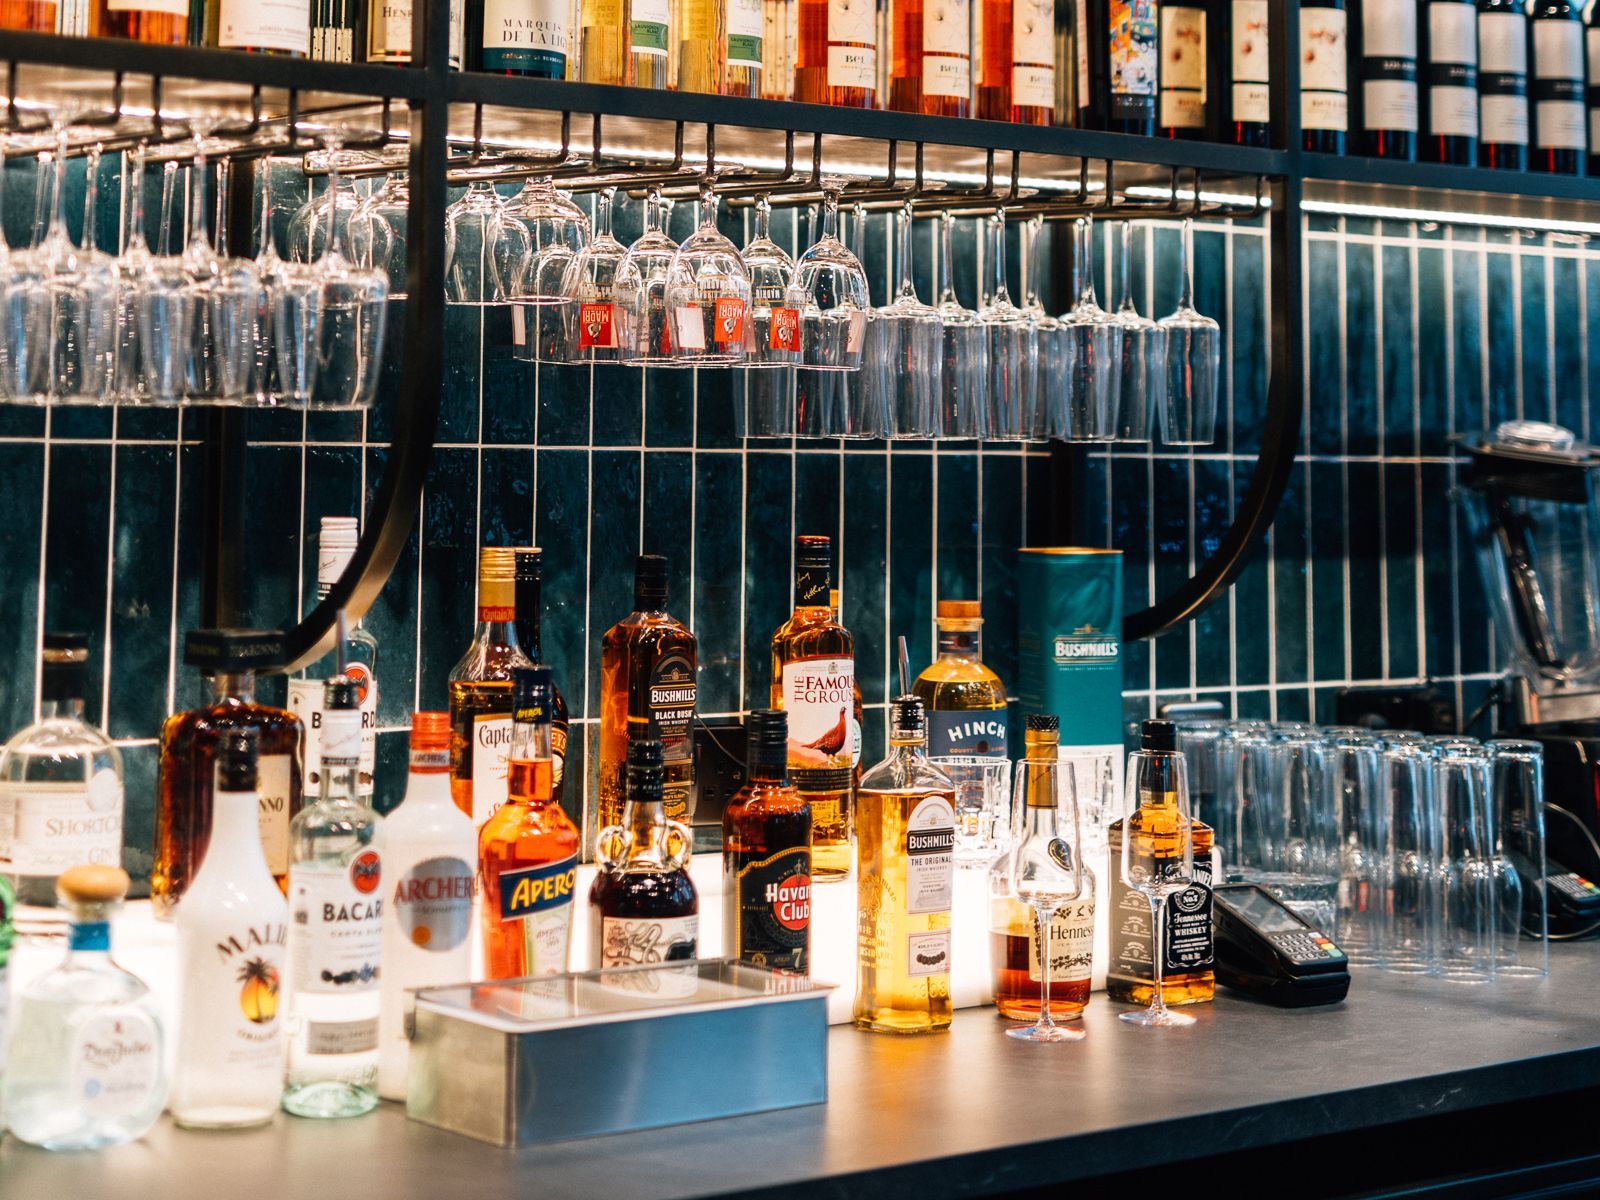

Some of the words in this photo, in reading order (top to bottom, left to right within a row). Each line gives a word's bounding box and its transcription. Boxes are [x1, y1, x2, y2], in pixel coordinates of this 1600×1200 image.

[503, 19, 561, 32] MARQUIS
[503, 30, 522, 42] DE
[530, 31, 547, 45] LA
[1054, 641, 1119, 657] BUSHMILLS
[651, 689, 697, 704] BUSHMILLS
[794, 675, 804, 703] THE
[516, 707, 543, 721] APEROL
[655, 711, 676, 720] BLACK
[947, 720, 1006, 742] HINCH
[909, 834, 954, 850] BUSHMILLS
[911, 858, 922, 867] THE
[924, 856, 952, 866] ORIGINAL
[1174, 926, 1208, 937] WHISKEY
[791, 947, 803, 970] 7
